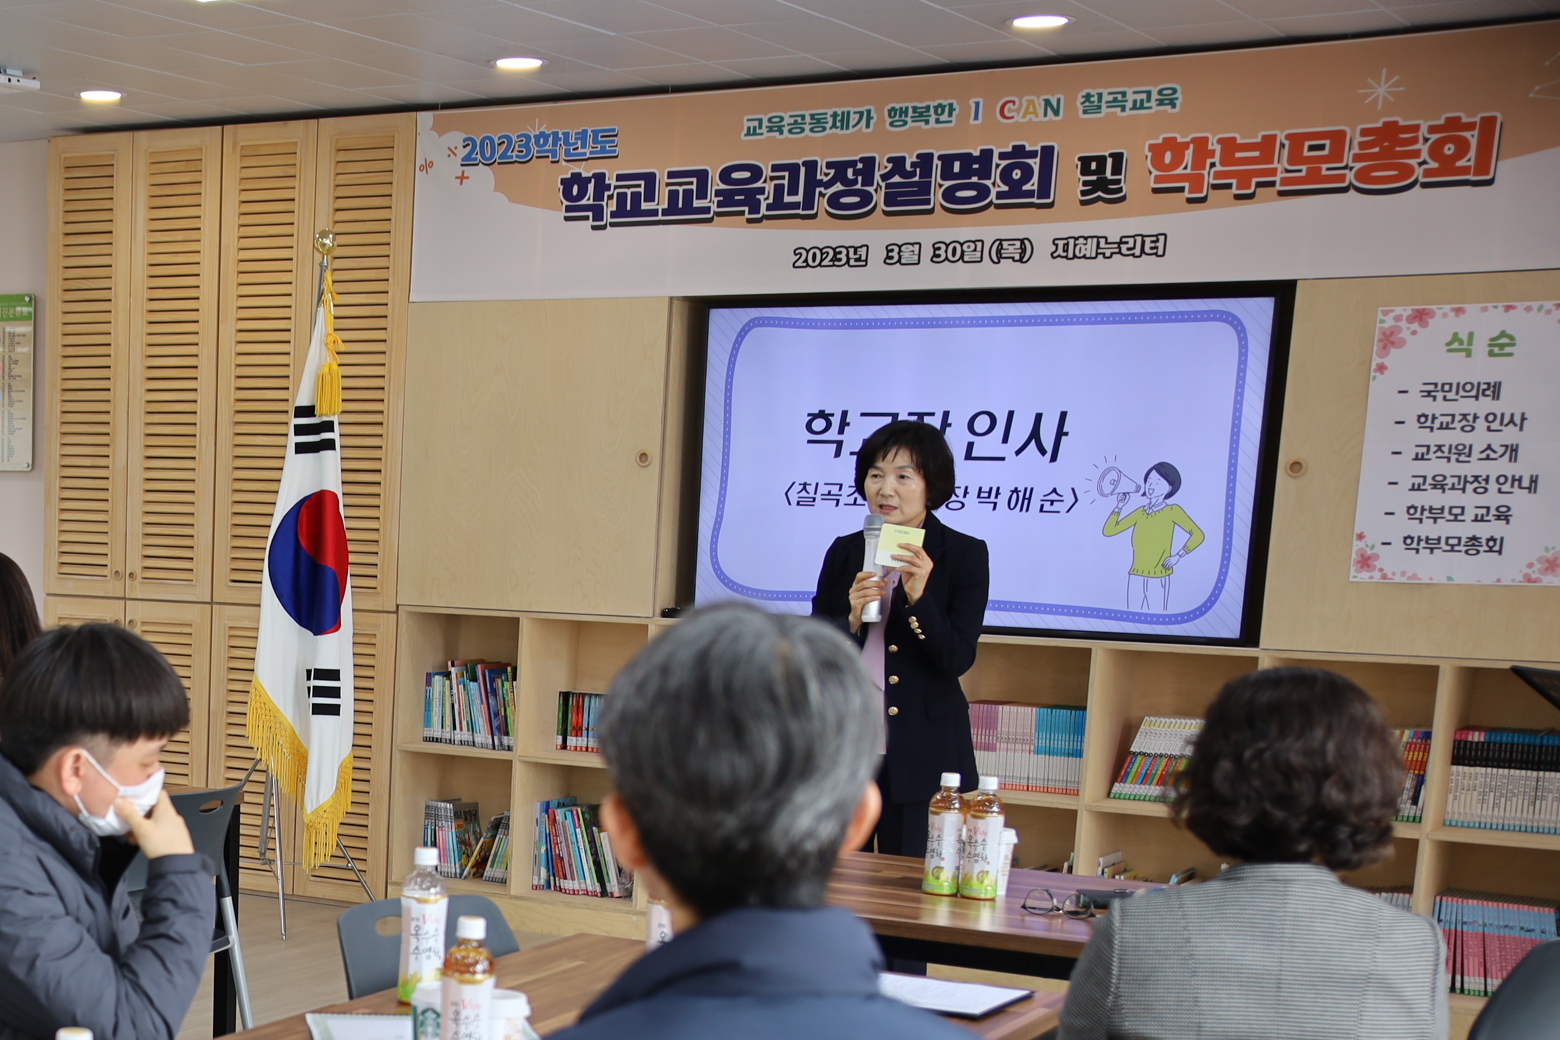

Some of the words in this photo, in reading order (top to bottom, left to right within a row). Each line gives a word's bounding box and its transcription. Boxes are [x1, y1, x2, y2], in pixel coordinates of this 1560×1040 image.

[743, 108, 874, 139] 교육공동체가
[887, 101, 957, 130] 행복한
[970, 100, 983, 122] I
[999, 96, 1062, 120] CAN
[1080, 84, 1180, 115] 칠곡교육
[460, 126, 619, 166] 2023학년도
[559, 143, 1058, 228] 학교교육과정설명회
[1077, 151, 1127, 203] 및
[1146, 114, 1501, 202] 학부모총회
[792, 245, 869, 269] 2023년
[884, 243, 921, 265] 3월
[931, 240, 983, 263] 30일
[989, 238, 1034, 264] (목)
[1052, 233, 1168, 260] 지혜누리터
[1419, 381, 1502, 402] 국민의례
[1416, 412, 1479, 433] 학교장
[1484, 411, 1528, 433] 인사
[964, 410, 1070, 463] 인사
[1411, 443, 1473, 464] 교직원
[1477, 443, 1520, 464] 소개
[1408, 474, 1490, 495] 교육과정
[1495, 473, 1539, 495] 안내
[1405, 504, 1466, 525] 학부모
[1470, 504, 1513, 525] 교육
[1402, 534, 1504, 556] 학부모총회
